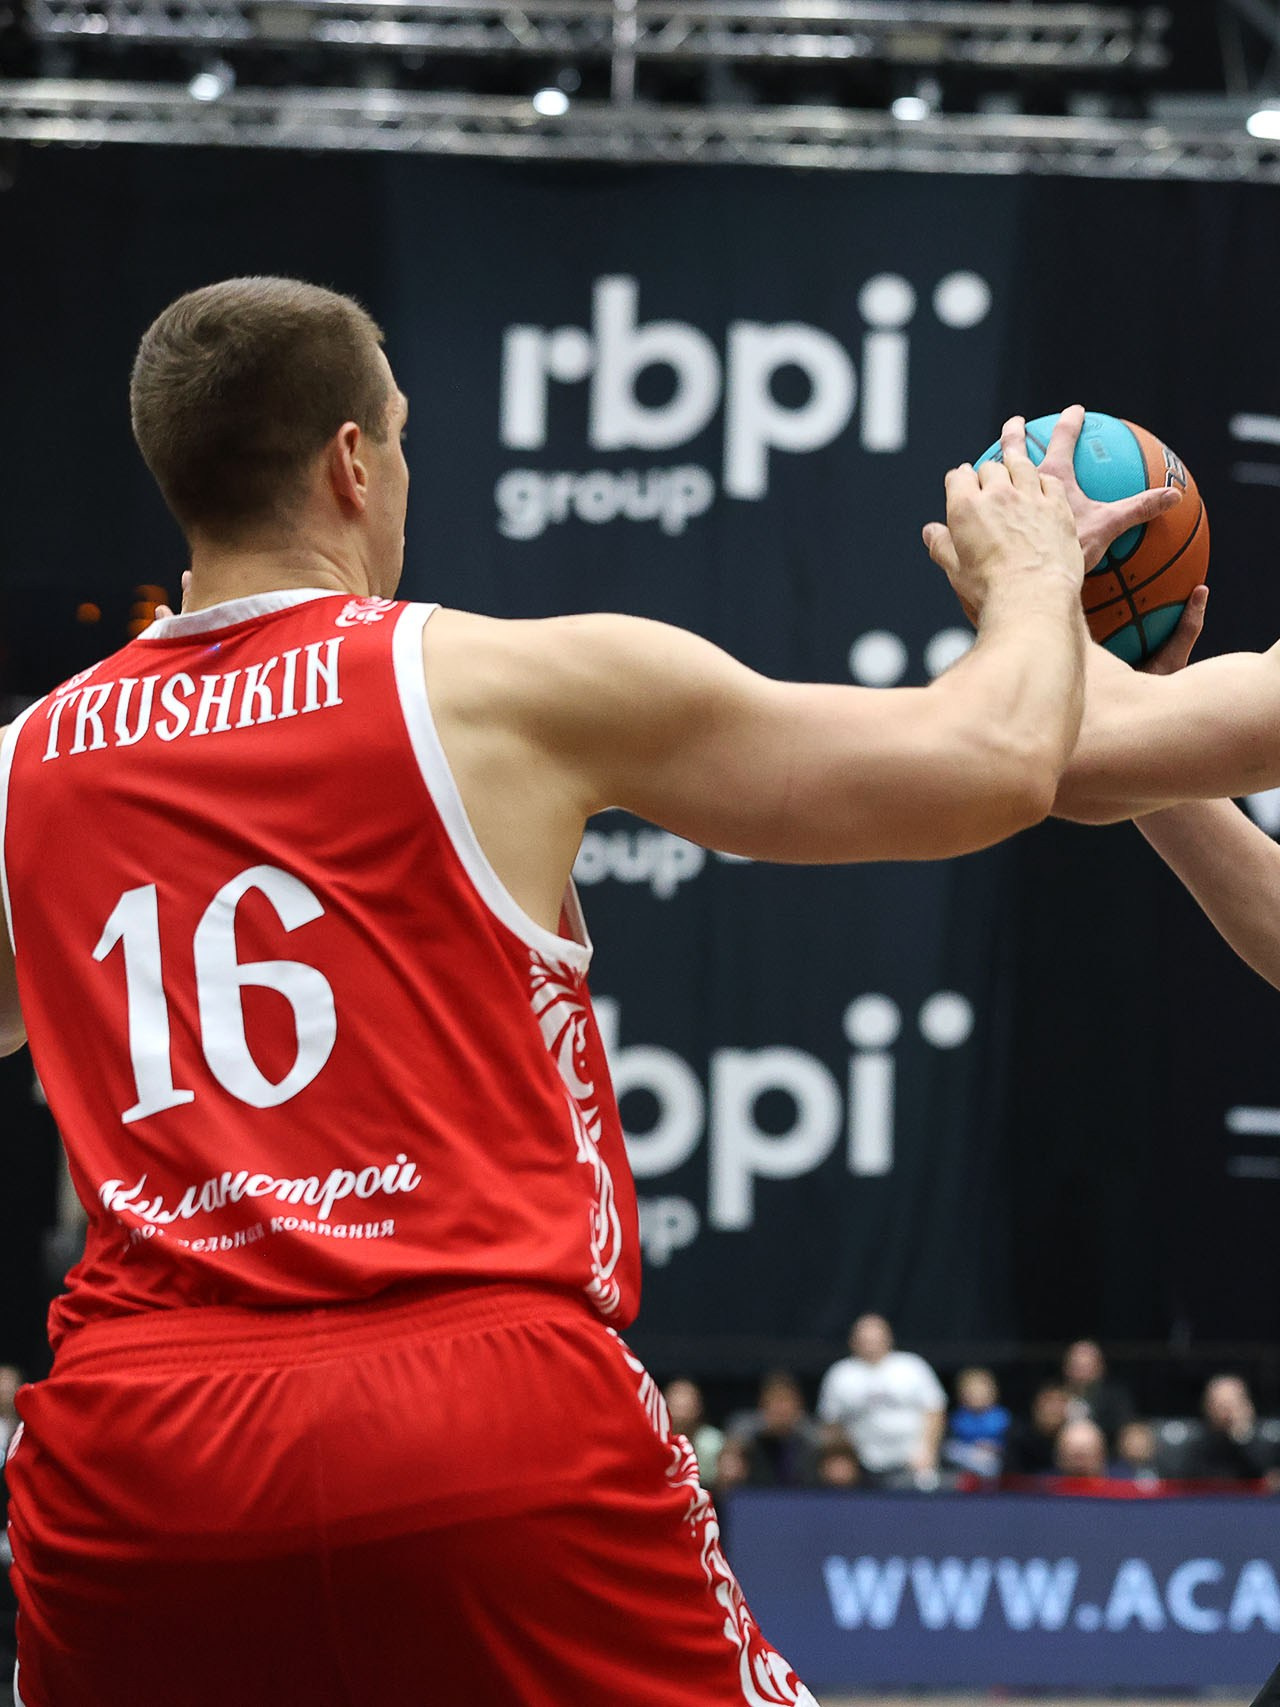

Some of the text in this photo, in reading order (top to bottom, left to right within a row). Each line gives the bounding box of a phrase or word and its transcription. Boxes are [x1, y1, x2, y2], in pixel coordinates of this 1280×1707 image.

[500, 272, 912, 501] rbpi
[494, 463, 717, 542] group
[42, 636, 345, 762] TRUSHKIN
[572, 829, 706, 900] oup
[91, 864, 338, 1124] 16
[590, 991, 905, 1232] bpi
[269, 1215, 395, 1239] компания
